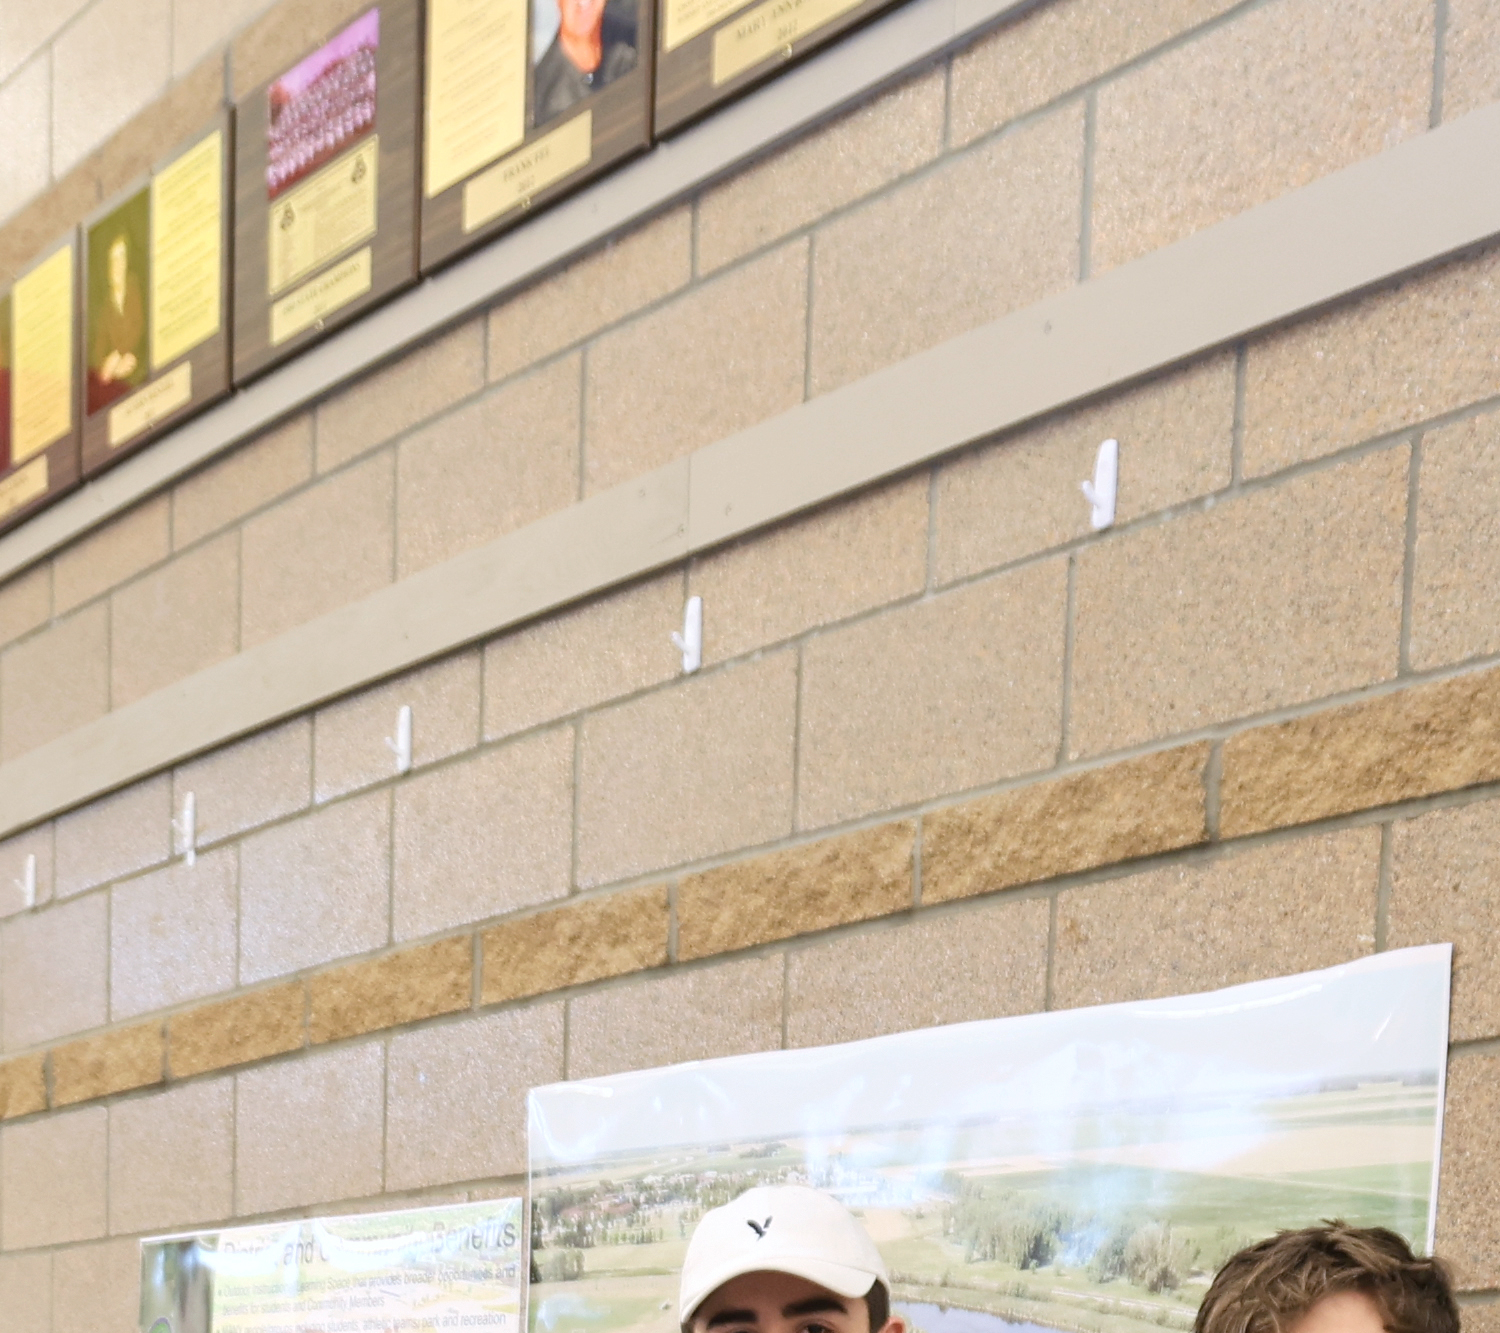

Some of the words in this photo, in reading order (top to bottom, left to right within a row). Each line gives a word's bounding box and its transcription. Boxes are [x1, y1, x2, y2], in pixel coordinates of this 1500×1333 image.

[432, 1215, 517, 1257] Benefits
[368, 1271, 402, 1288] provides
[495, 1264, 516, 1279] and
[421, 1314, 440, 1330] park
[442, 1311, 459, 1327] and
[460, 1311, 507, 1328] recreation
